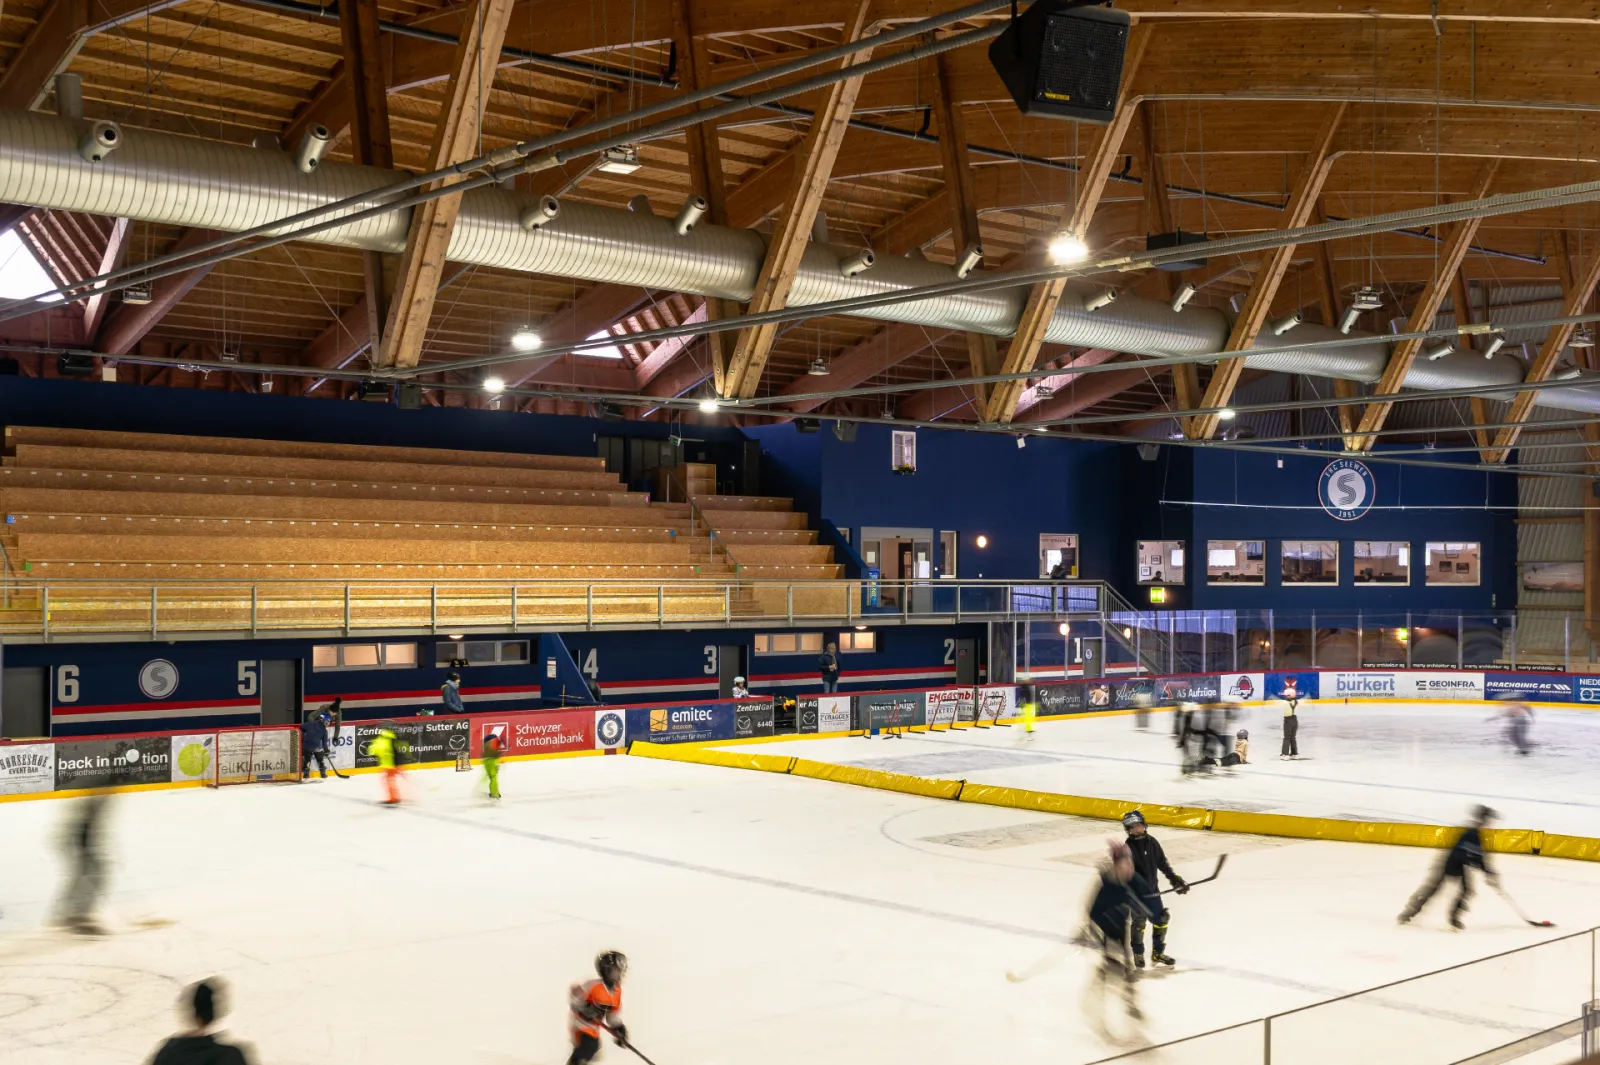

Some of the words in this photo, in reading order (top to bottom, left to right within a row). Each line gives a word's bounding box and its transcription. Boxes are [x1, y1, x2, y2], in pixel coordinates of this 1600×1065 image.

[1324, 464, 1338, 477] EHC
[1339, 461, 1368, 477] SEEWEN
[1338, 510, 1356, 518] 1951
[943, 638, 955, 665] 2
[1074, 637, 1083, 663] 1
[583, 648, 599, 679] 4
[703, 645, 717, 674] 3
[57, 664, 80, 703] 6
[237, 660, 257, 696] 5
[1336, 674, 1395, 691] bürkert
[1429, 680, 1475, 688] GEOINFRA
[1177, 689, 1187, 698] AS
[1188, 687, 1217, 698] Aufzüge
[808, 700, 818, 708] AG
[672, 706, 713, 723] emitec
[426, 724, 454, 732] Sutter
[456, 721, 469, 730] AG
[516, 722, 562, 736] Schwyzer
[757, 720, 773, 728] 6440
[516, 732, 584, 747] Kantonalbank
[409, 744, 443, 752] Brunnen
[0, 753, 48, 770] HORSESHOE
[58, 756, 93, 770] back
[96, 756, 109, 768] in
[58, 766, 142, 778] Physiotherapeutisches
[144, 764, 168, 772] Institut
